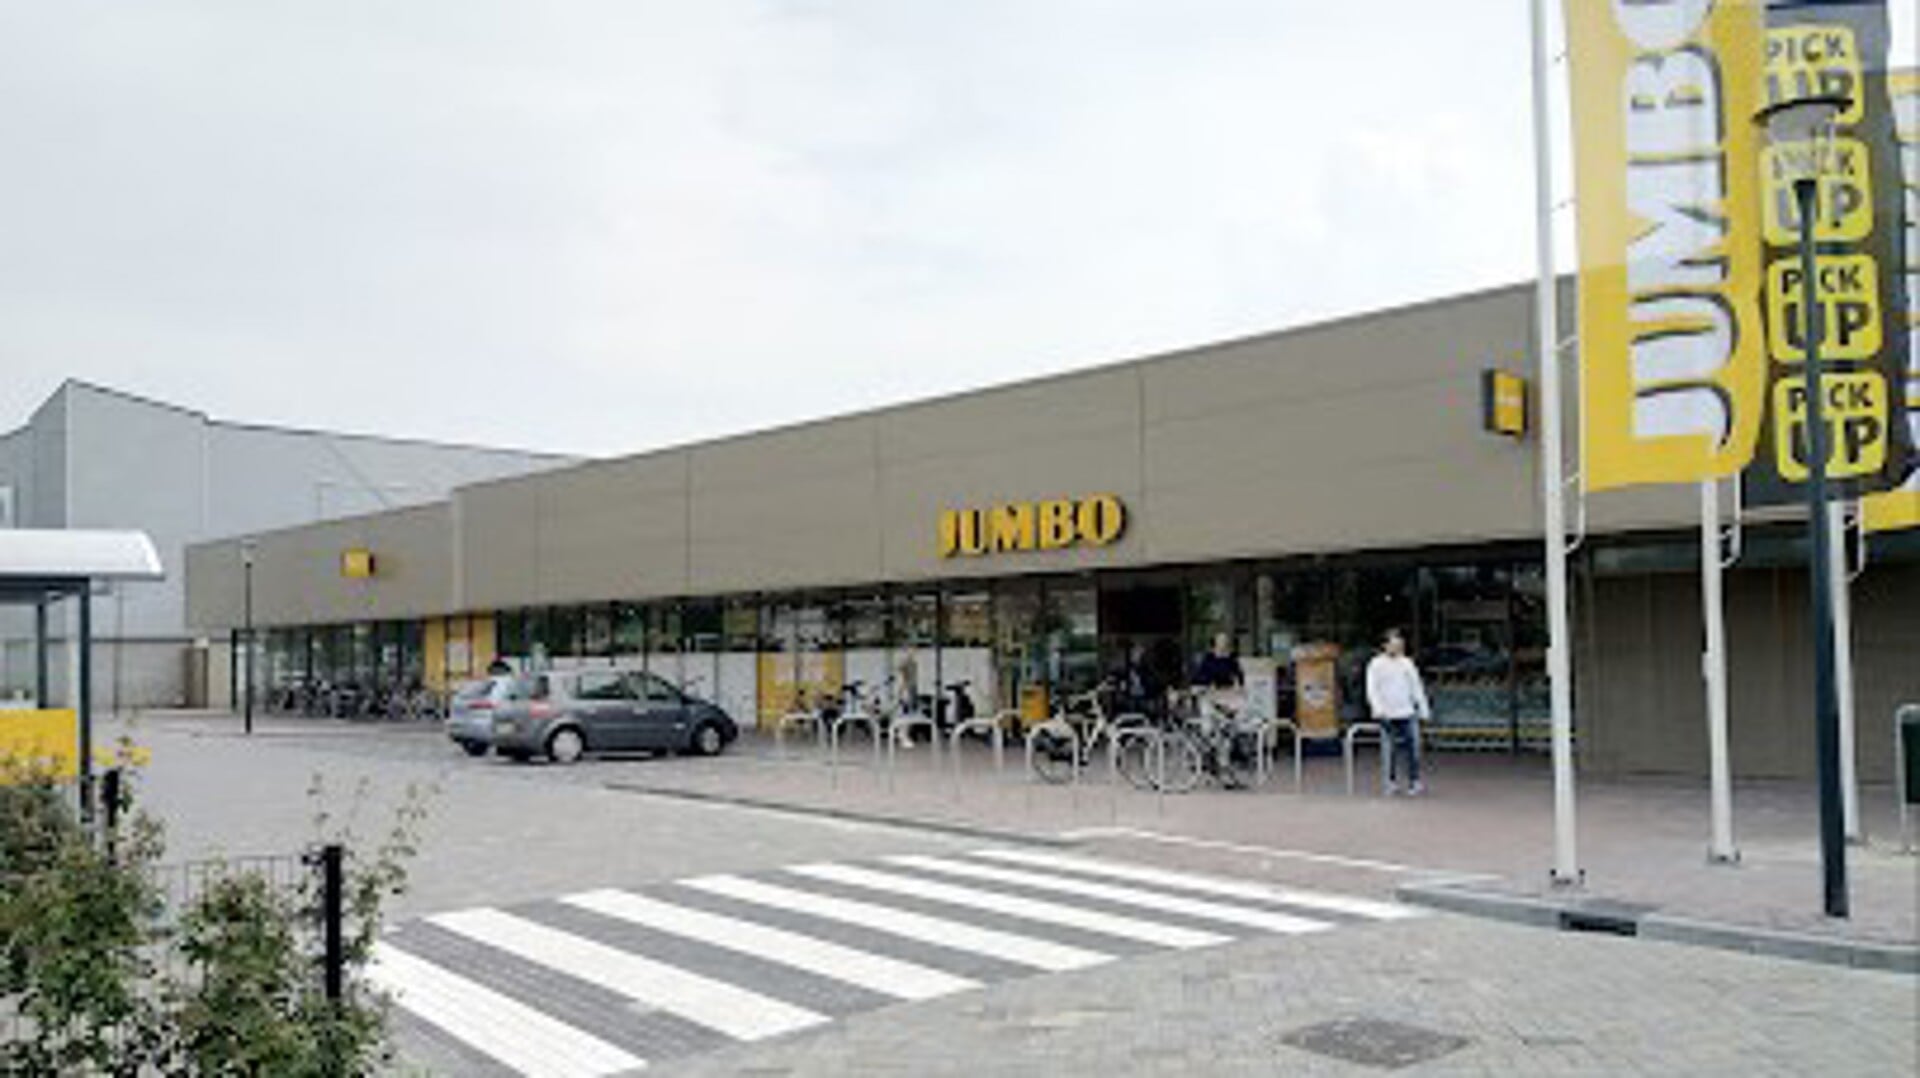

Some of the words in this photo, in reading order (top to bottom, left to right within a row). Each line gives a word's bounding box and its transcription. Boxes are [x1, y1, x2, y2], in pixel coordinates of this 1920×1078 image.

[1781, 264, 1862, 295] PCK
[1783, 301, 1872, 350] UP
[1788, 382, 1874, 413] PCK
[1789, 416, 1881, 467] UP
[937, 494, 1127, 558] JUMBO
